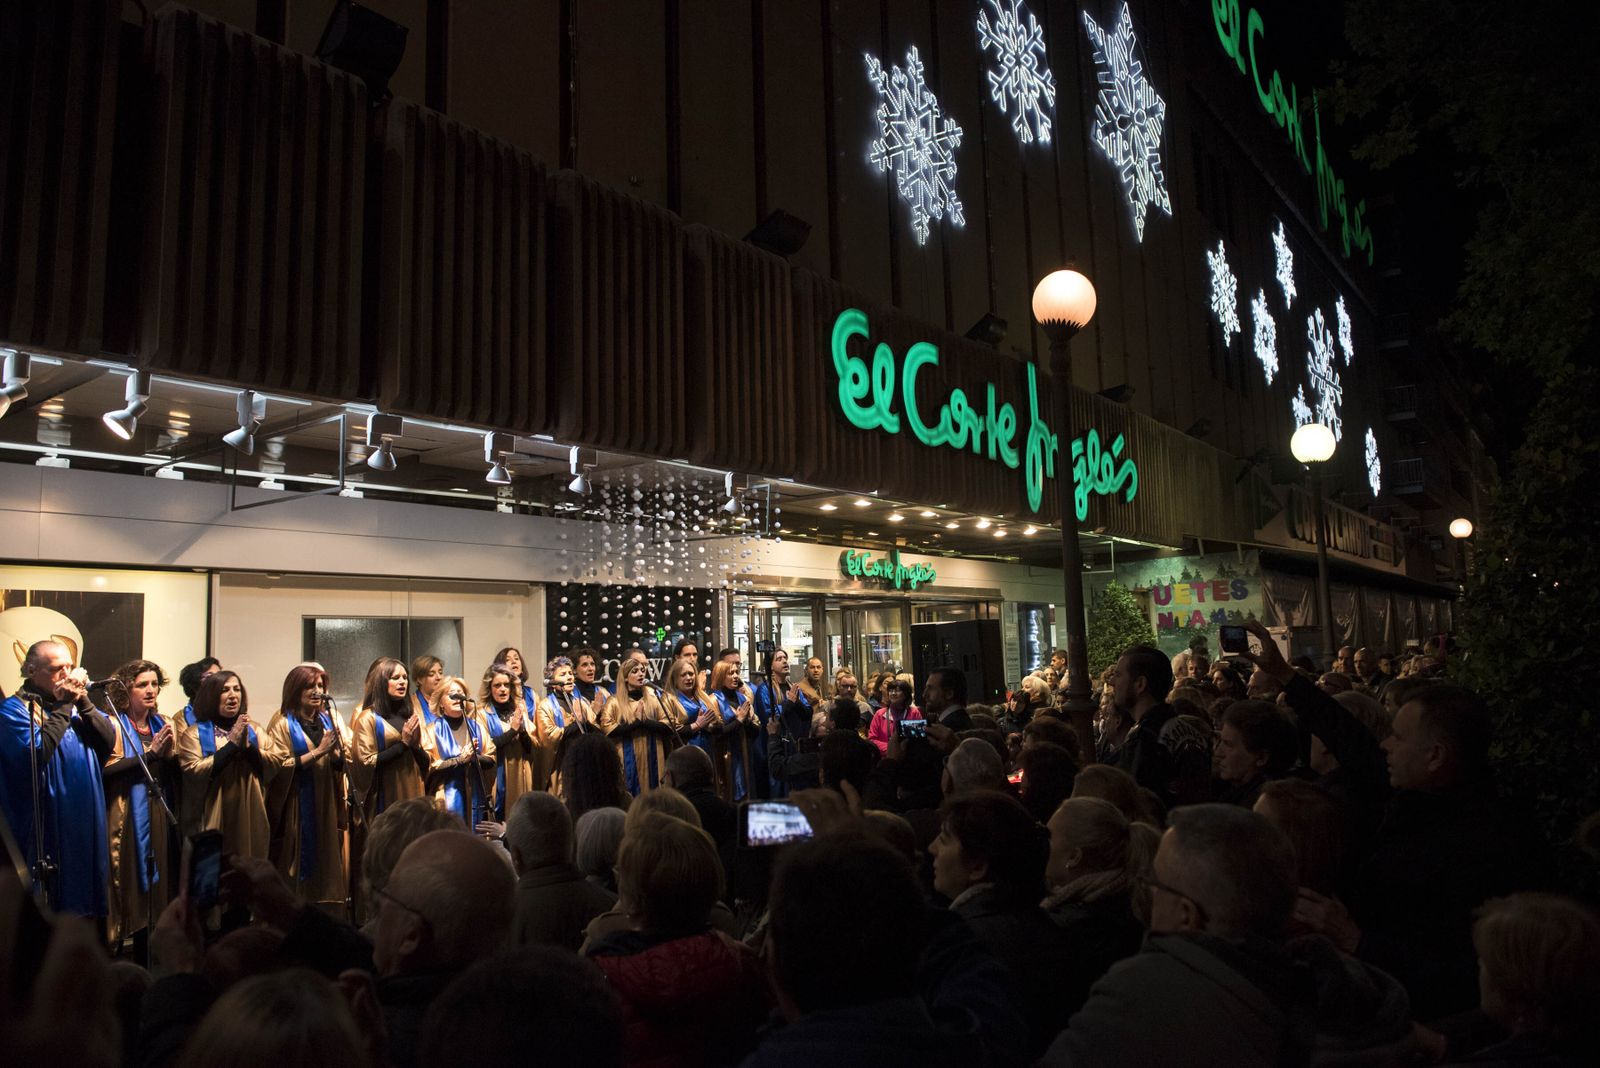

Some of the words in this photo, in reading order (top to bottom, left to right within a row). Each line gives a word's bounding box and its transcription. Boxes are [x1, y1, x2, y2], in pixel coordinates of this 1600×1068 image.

[831, 308, 900, 434] El
[902, 341, 1020, 469] Corte
[846, 549, 862, 576] El
[861, 551, 894, 580] Corte
[895, 548, 937, 590] Inglés
